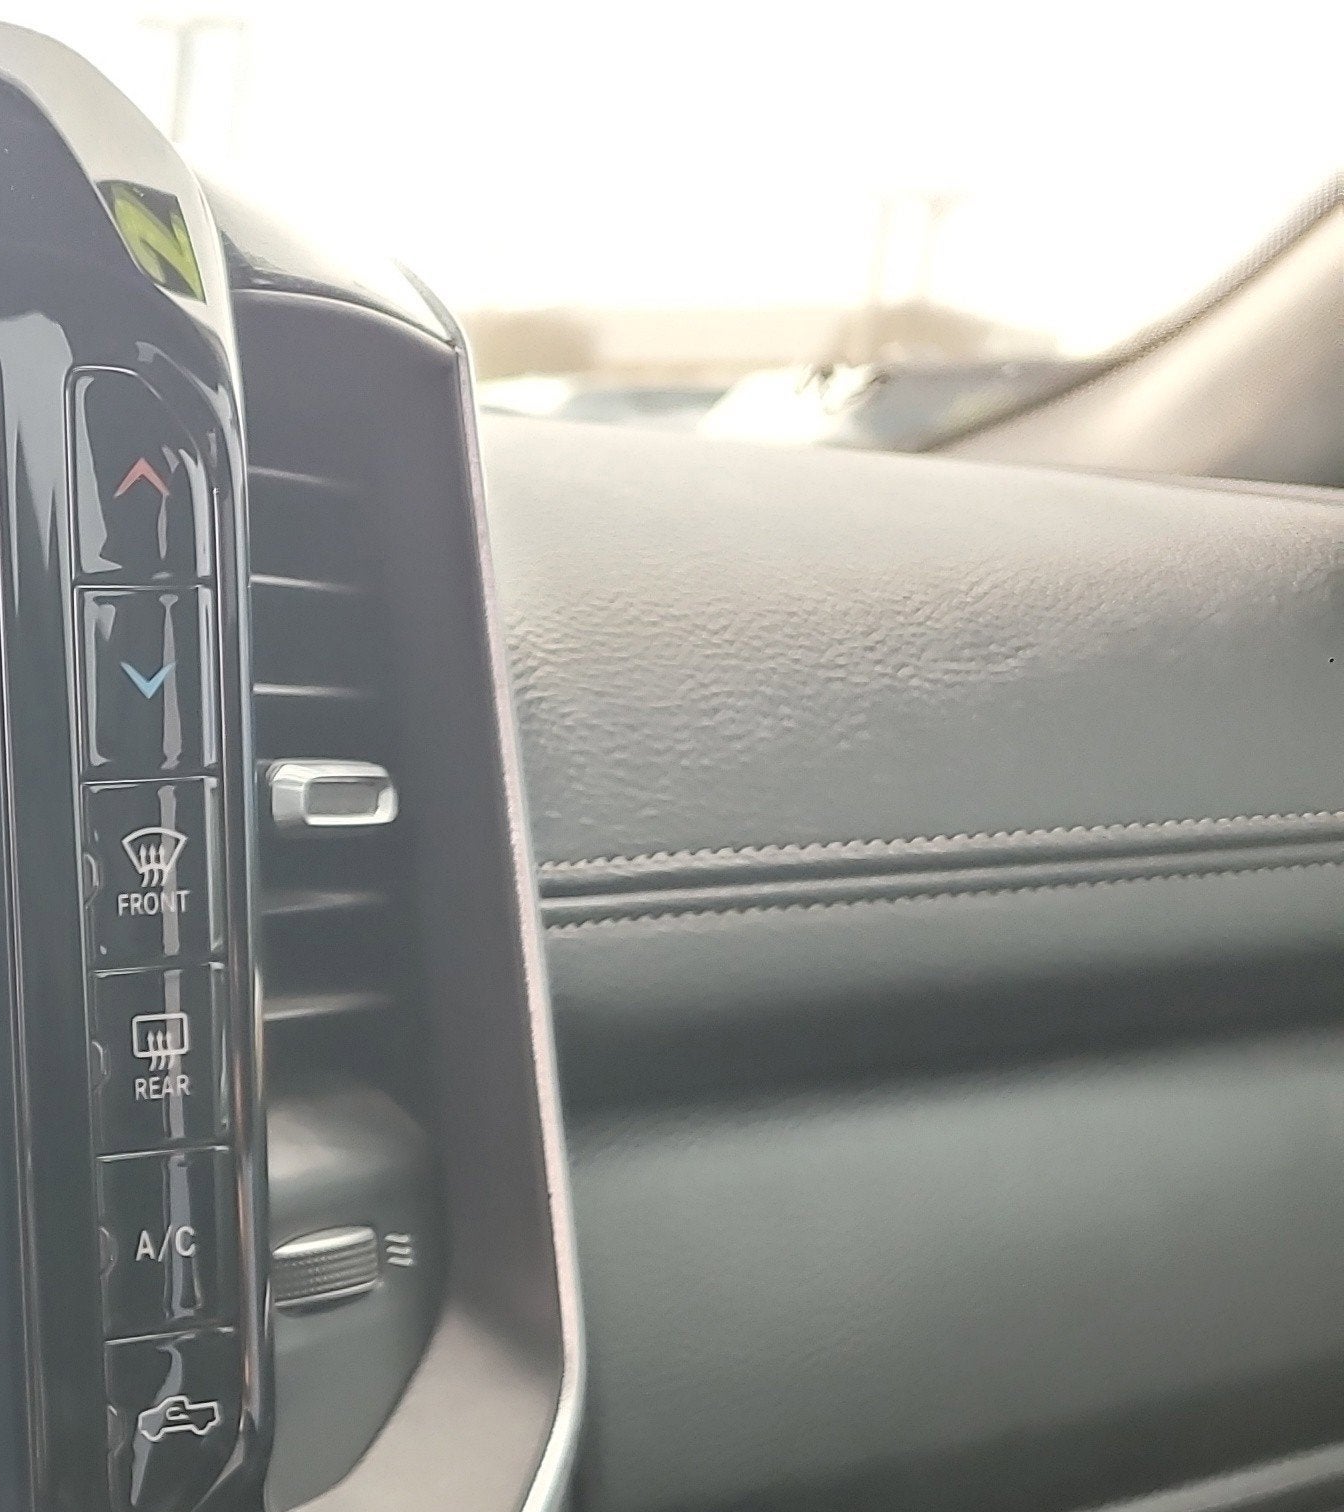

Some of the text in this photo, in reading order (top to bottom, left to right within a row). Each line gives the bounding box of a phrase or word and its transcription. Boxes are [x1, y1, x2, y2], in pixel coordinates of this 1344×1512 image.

[116, 890, 191, 916] FRONT
[134, 1076, 190, 1100] REAR
[135, 1226, 197, 1261] A/C
